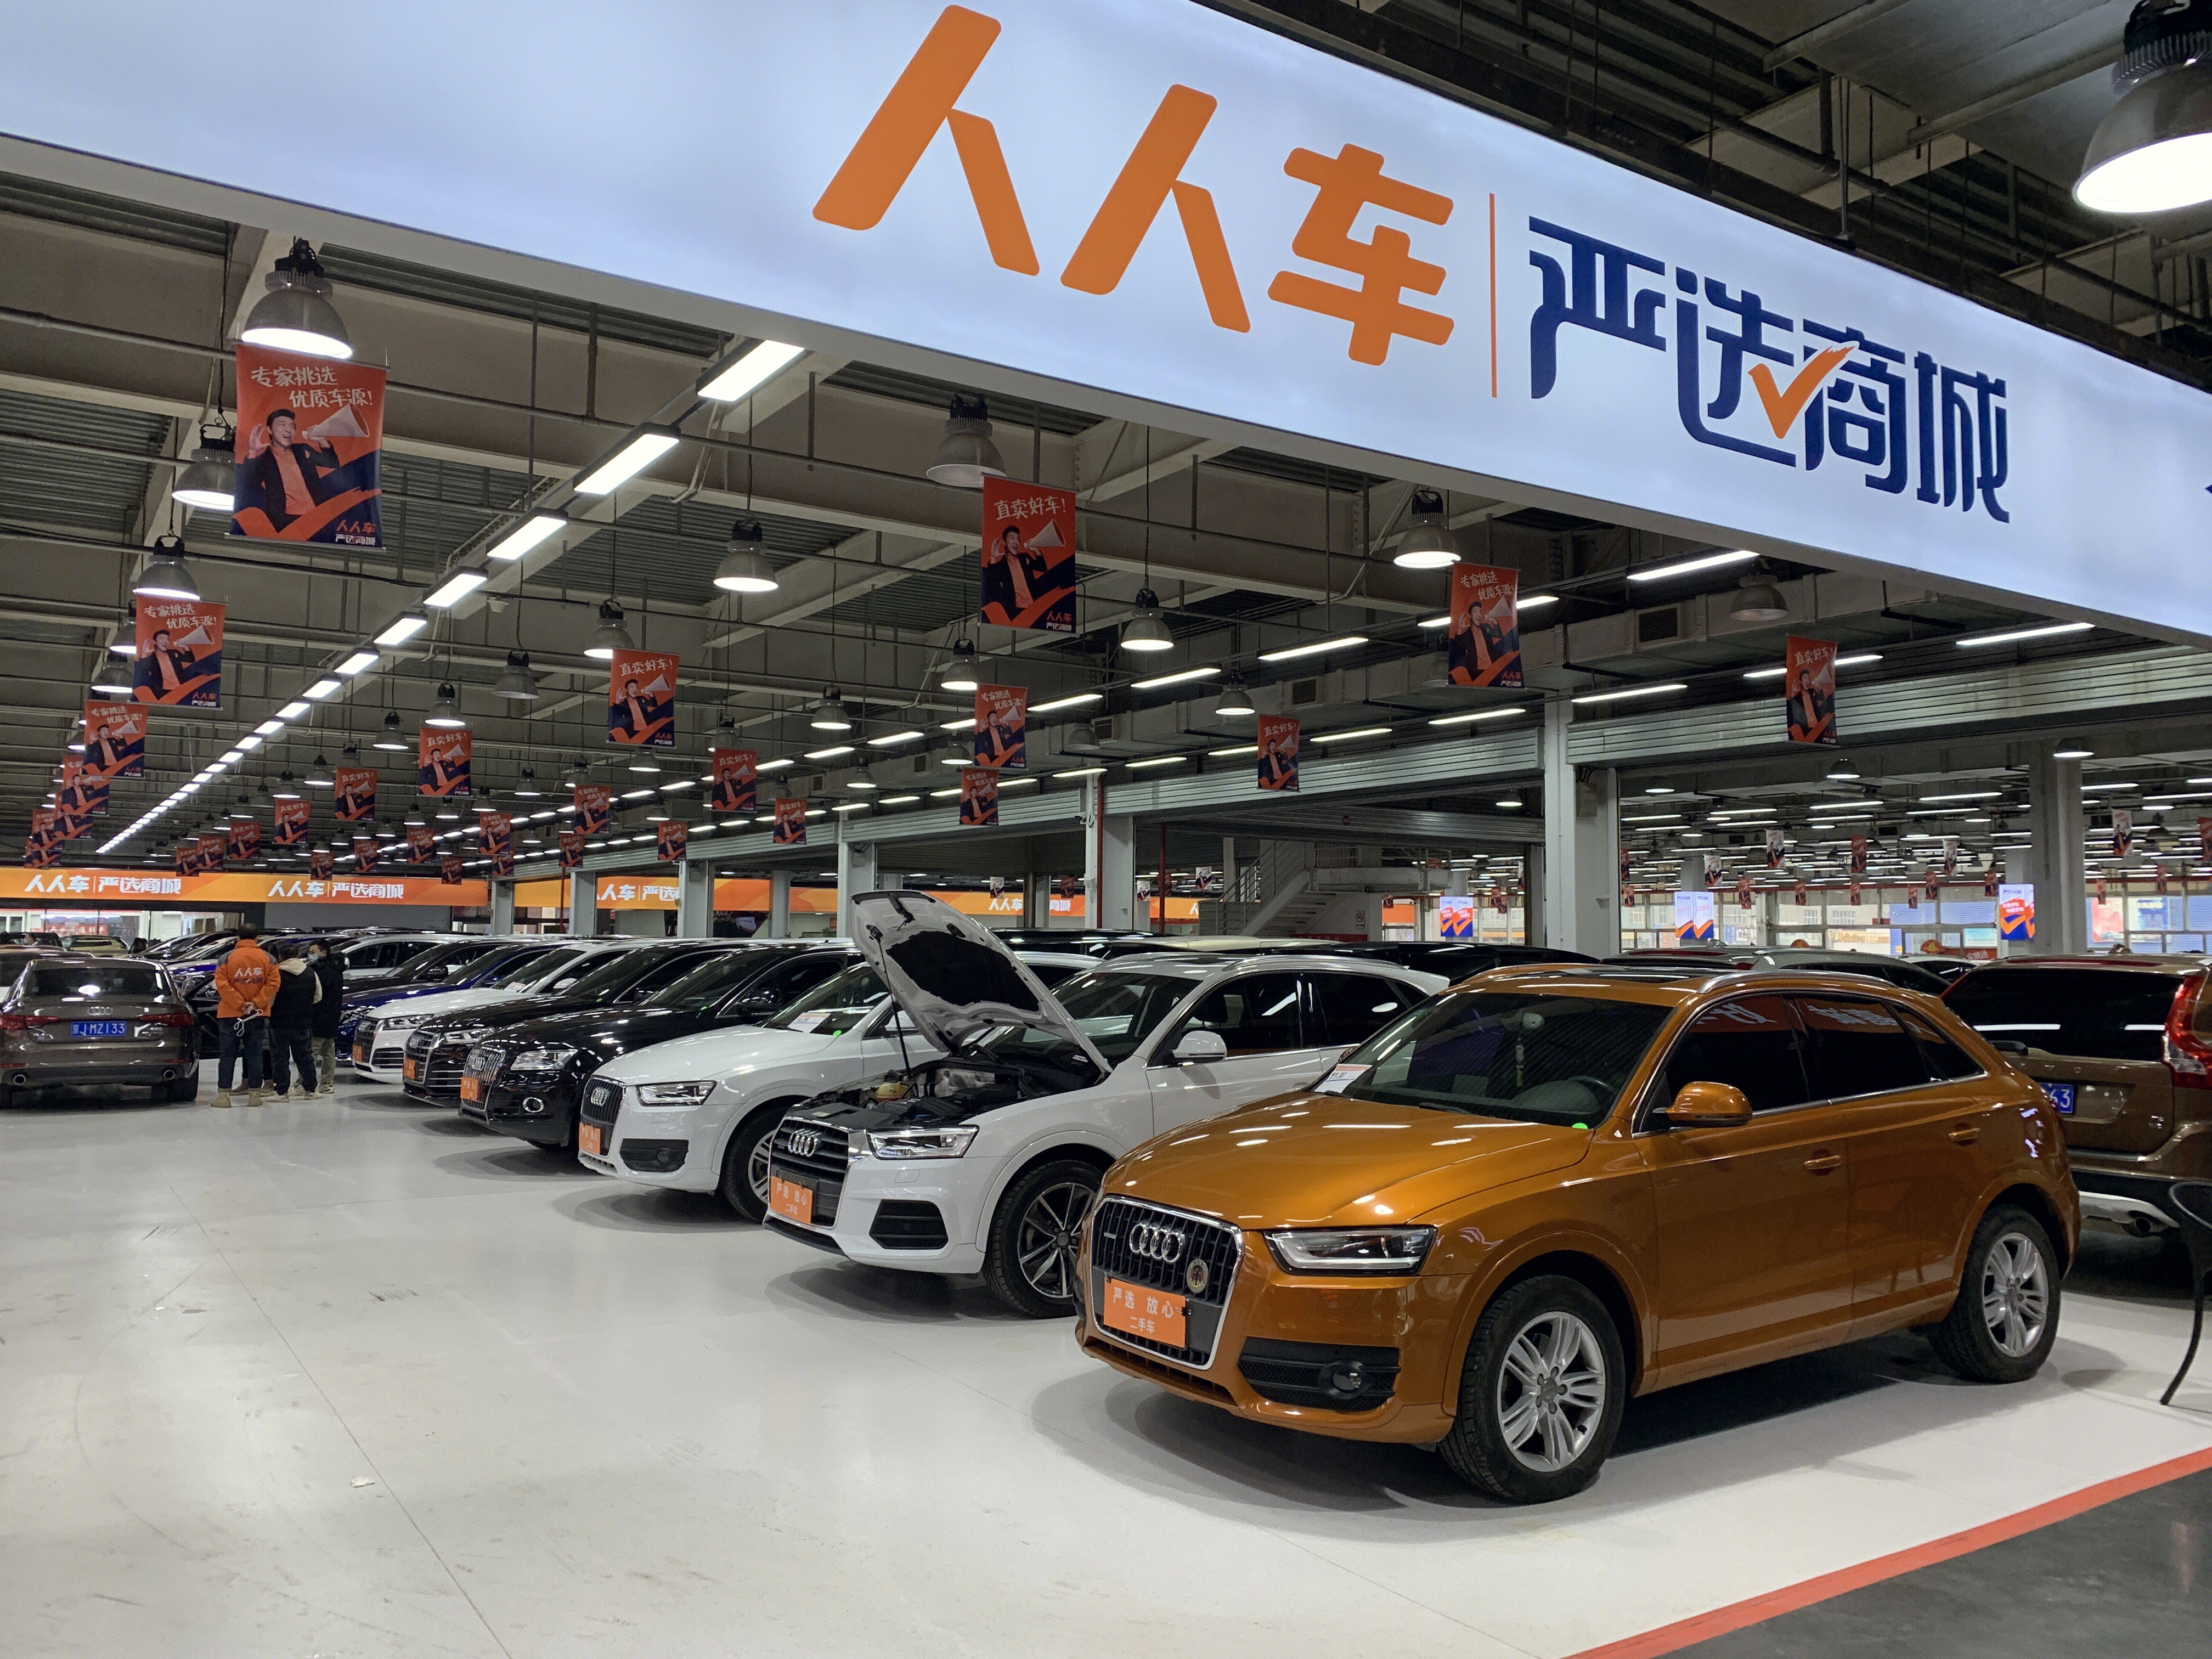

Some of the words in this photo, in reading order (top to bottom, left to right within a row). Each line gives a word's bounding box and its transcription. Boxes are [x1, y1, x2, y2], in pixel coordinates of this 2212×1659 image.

[814, 6, 1453, 365] 人人车
[1526, 217, 2008, 523] 严选商城
[251, 366, 339, 387] 专家挑选
[289, 388, 373, 408] 优质车源!
[995, 495, 1066, 521] 直卖好车!
[336, 519, 376, 534] 人人车
[1460, 571, 1498, 588] 专家挑选
[1477, 583, 1514, 600] 优质车源!
[144, 602, 196, 618] 专家挑选
[1046, 611, 1071, 622] 人人车
[166, 615, 217, 629] 优质车源!
[1795, 645, 1833, 667] 直卖好车!
[619, 658, 674, 677] 直卖好车!
[981, 689, 1012, 702] 专家挑选
[1263, 723, 1297, 737] 直卖好车!
[427, 732, 467, 747] 直卖好车!
[718, 754, 753, 766] 直卖好车!
[26, 874, 90, 894] 人人车
[99, 877, 182, 895] 严选商城
[268, 880, 324, 898] 人人车
[332, 883, 404, 899] 严选商城
[597, 884, 635, 901] 人车
[642, 885, 679, 901] 严选
[988, 898, 1023, 910] 人人车
[234, 967, 263, 978] 人人车
[1114, 1287, 1135, 1310] 严选
[1147, 1295, 1174, 1318] 放心
[1130, 1316, 1155, 1334] 二手车
